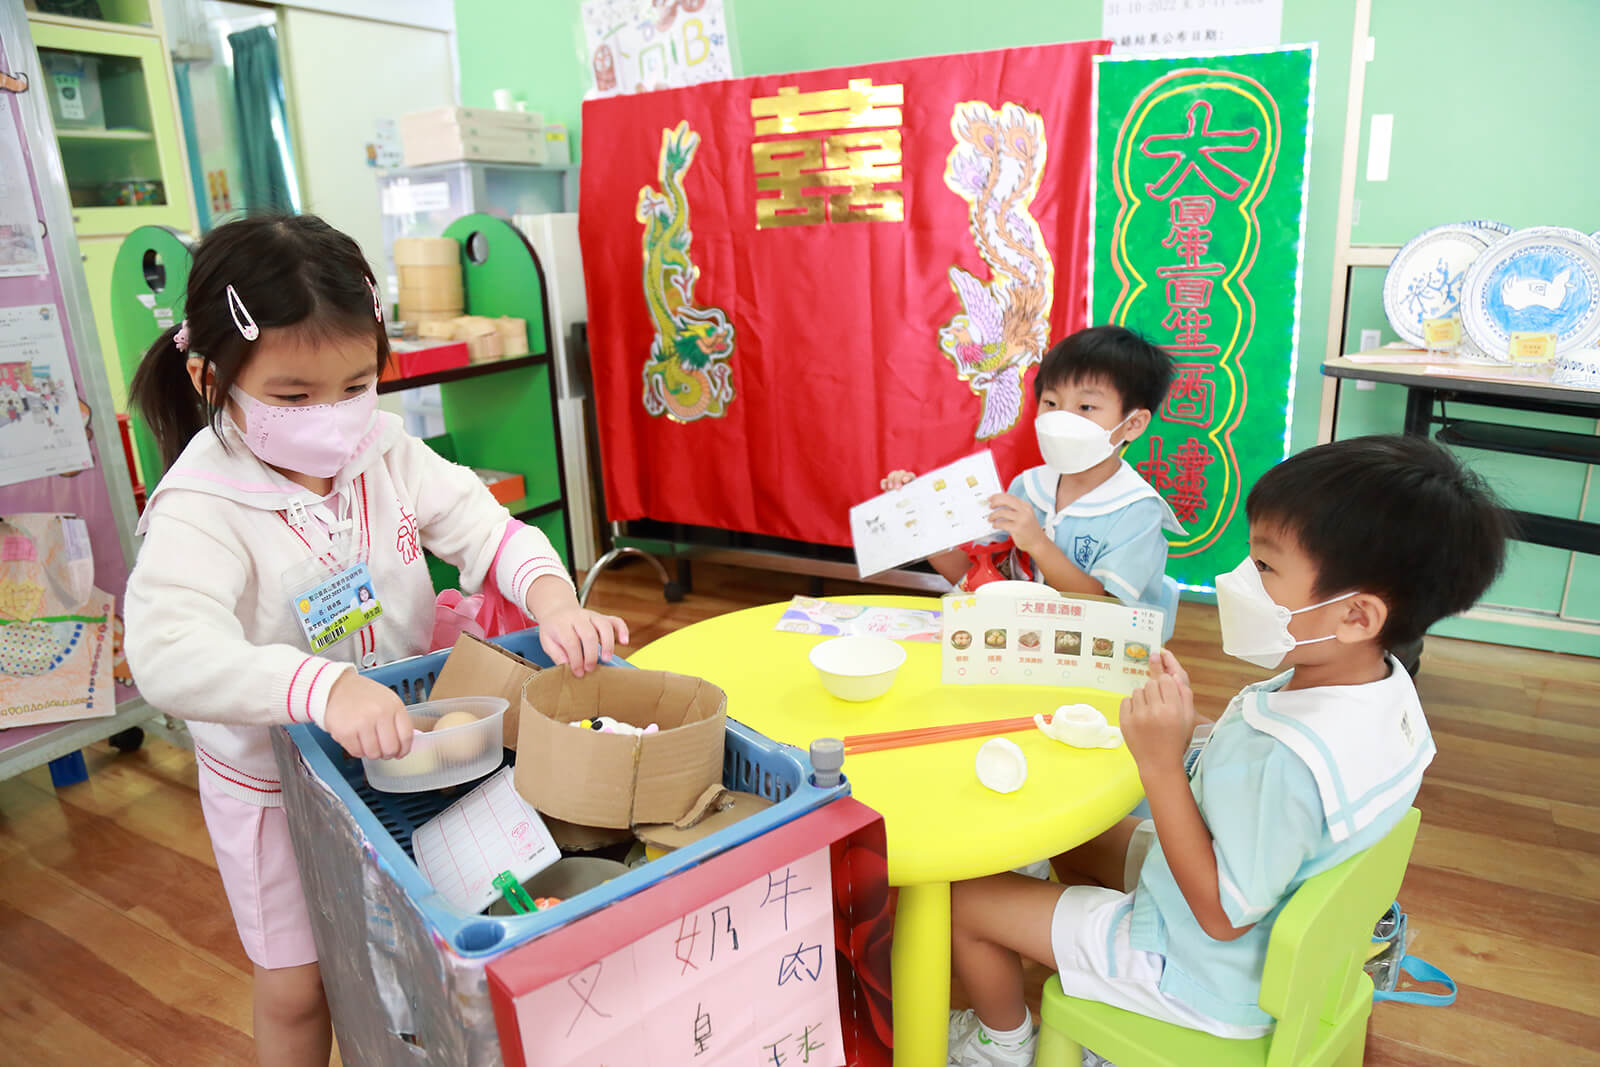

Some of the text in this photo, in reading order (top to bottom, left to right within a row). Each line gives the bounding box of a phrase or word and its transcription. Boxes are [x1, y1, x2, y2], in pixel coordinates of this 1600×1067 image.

[1021, 601, 1082, 617] 大星星酒樓
